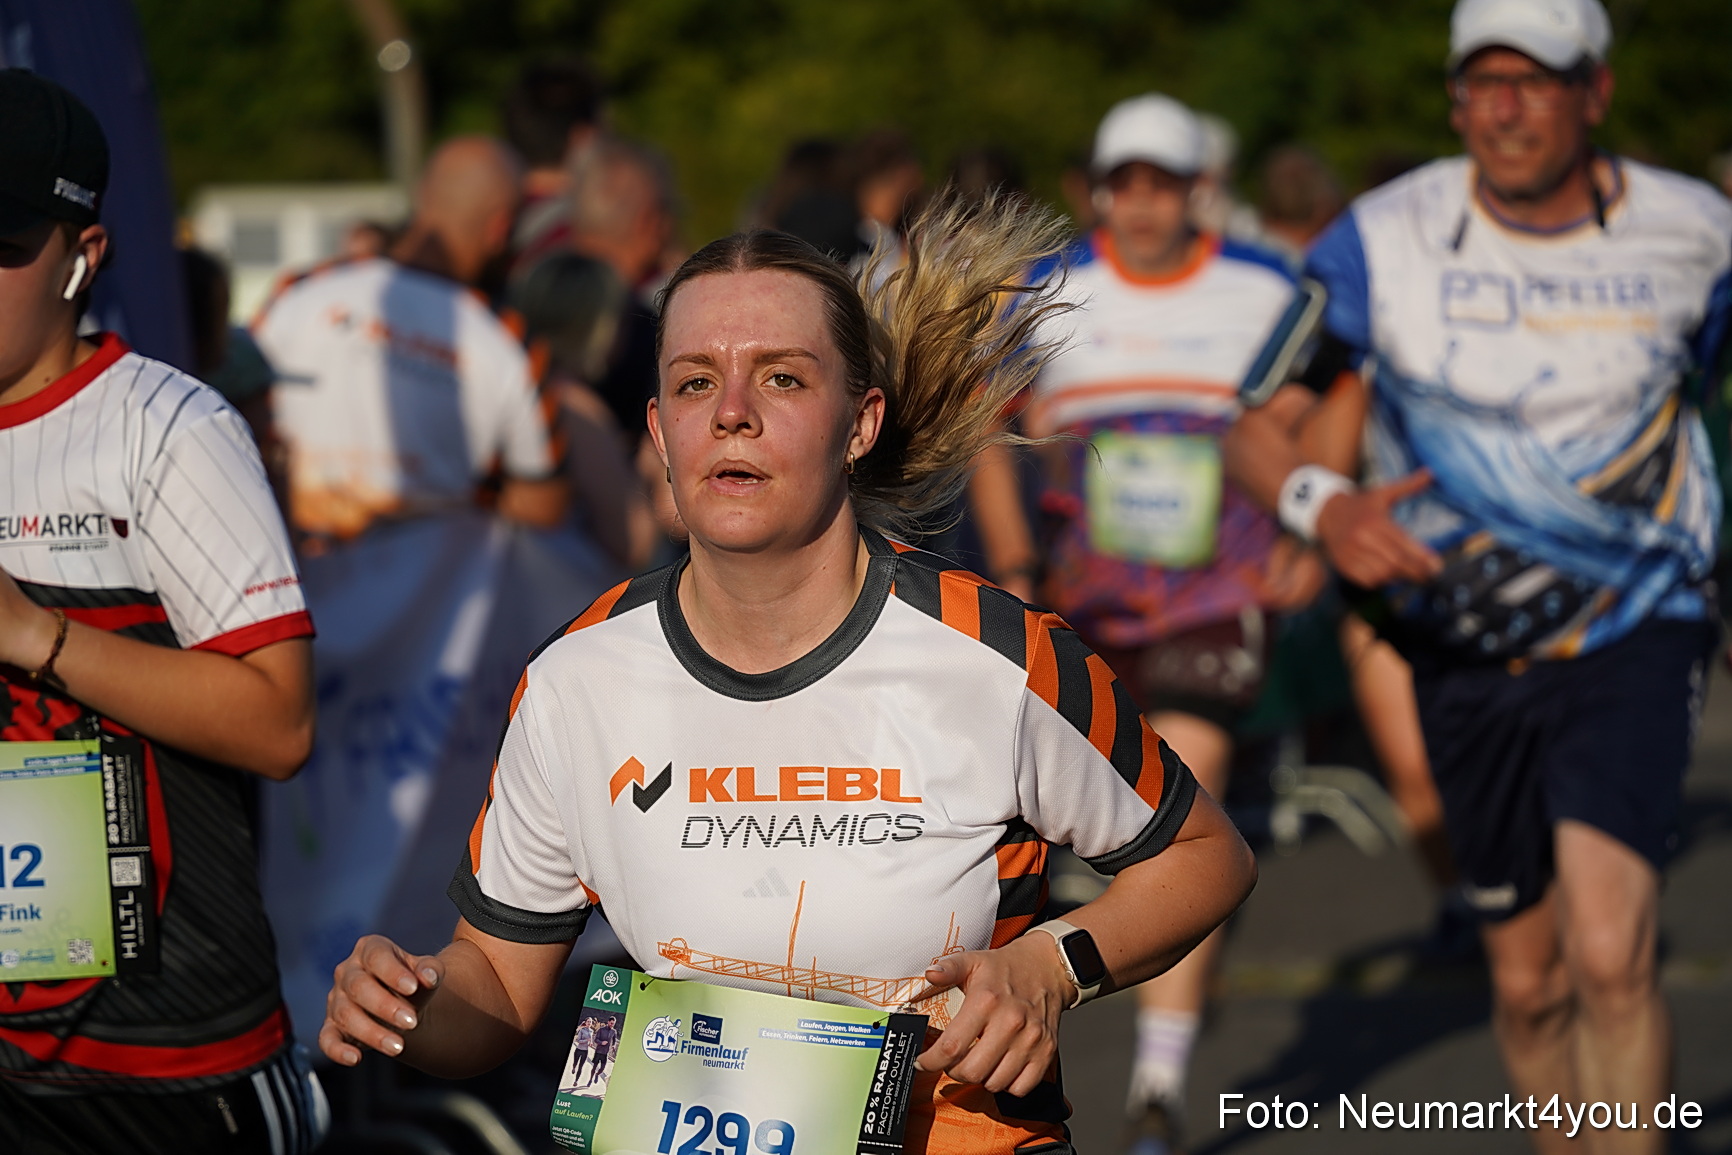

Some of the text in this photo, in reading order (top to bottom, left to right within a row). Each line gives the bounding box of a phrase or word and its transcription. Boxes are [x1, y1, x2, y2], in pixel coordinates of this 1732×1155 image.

[102, 754, 117, 811] RABATT
[689, 766, 922, 803] KLEBL
[108, 823, 120, 845] 20
[681, 813, 925, 848] DYNAMICS
[0, 903, 42, 921] Fink
[119, 890, 138, 958] HILTL
[590, 988, 623, 1005] AOK
[696, 1023, 719, 1035] Fischer
[800, 1021, 871, 1034] Laufen, Joggen, Walken
[783, 1032, 808, 1042] Trinken,
[809, 1035, 829, 1044] Feiern,
[830, 1037, 866, 1047] Netzwerken
[681, 1040, 749, 1060] Firmenlauf
[703, 1059, 745, 1070] neumarkt
[864, 1030, 897, 1135] 20 % RABATT
[877, 1080, 895, 1135] FACTORY
[890, 1032, 907, 1078] OUTLET
[556, 1099, 571, 1107] Lust
[567, 1110, 594, 1120] Laufen?
[657, 1100, 795, 1155] 1299
